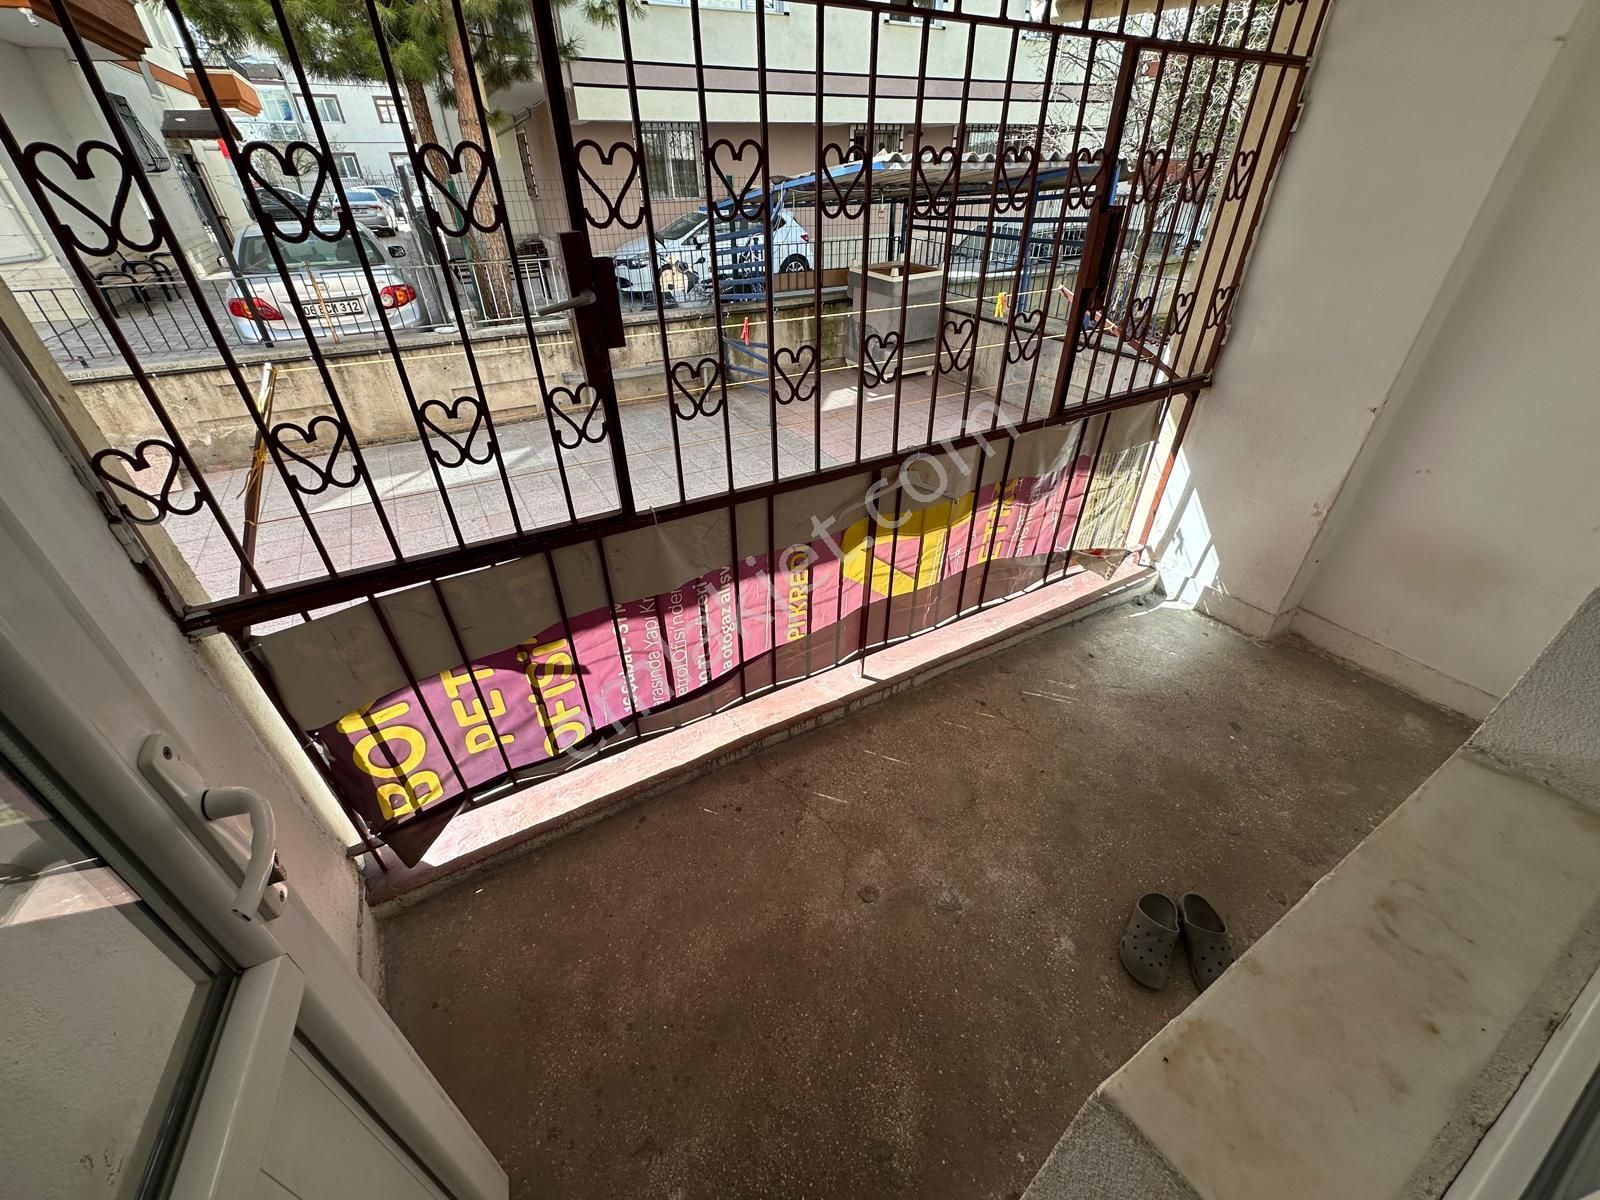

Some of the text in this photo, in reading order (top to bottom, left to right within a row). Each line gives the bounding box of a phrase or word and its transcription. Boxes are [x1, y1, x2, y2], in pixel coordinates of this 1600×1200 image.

[340, 301, 359, 312] 312
[643, 616, 660, 650] Yapı
[721, 605, 736, 658] otogaz
